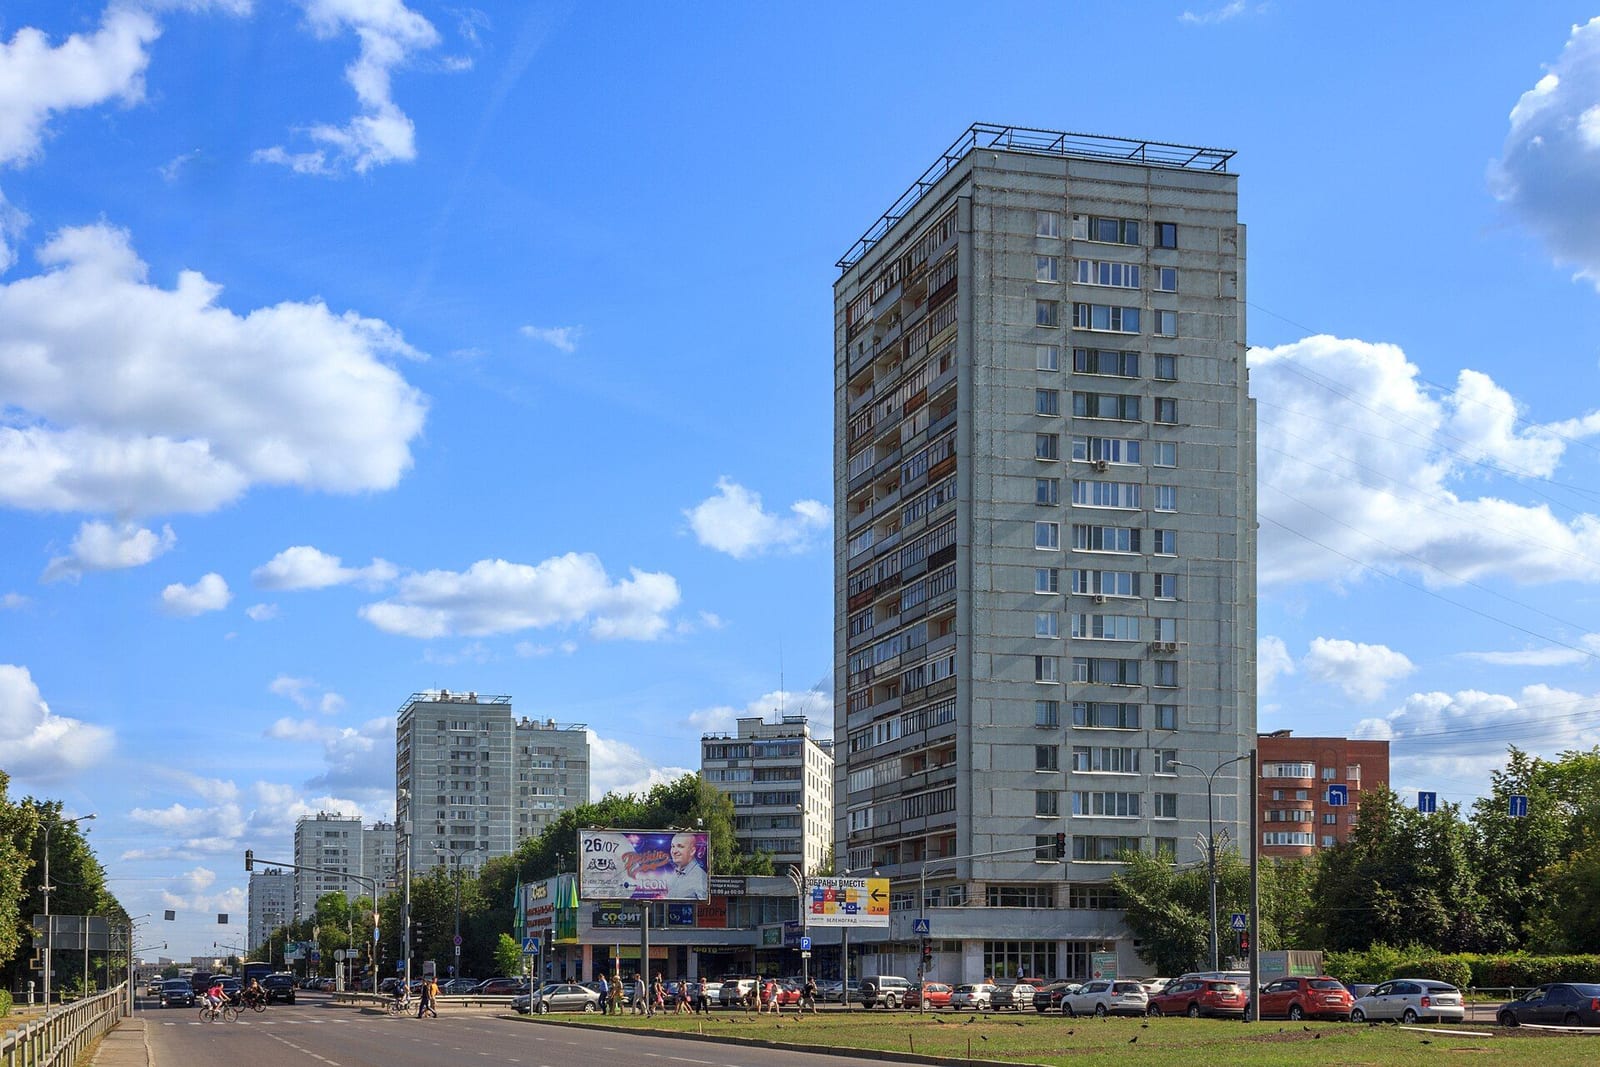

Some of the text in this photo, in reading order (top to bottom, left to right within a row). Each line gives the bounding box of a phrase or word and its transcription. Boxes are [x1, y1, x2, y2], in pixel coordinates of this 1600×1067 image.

[584, 838, 620, 853] 26/07
[640, 879, 668, 890] ICON
[838, 880, 865, 888] ВМЕСТЕ
[602, 912, 642, 923] СОФИТ
[803, 939, 809, 948] P
